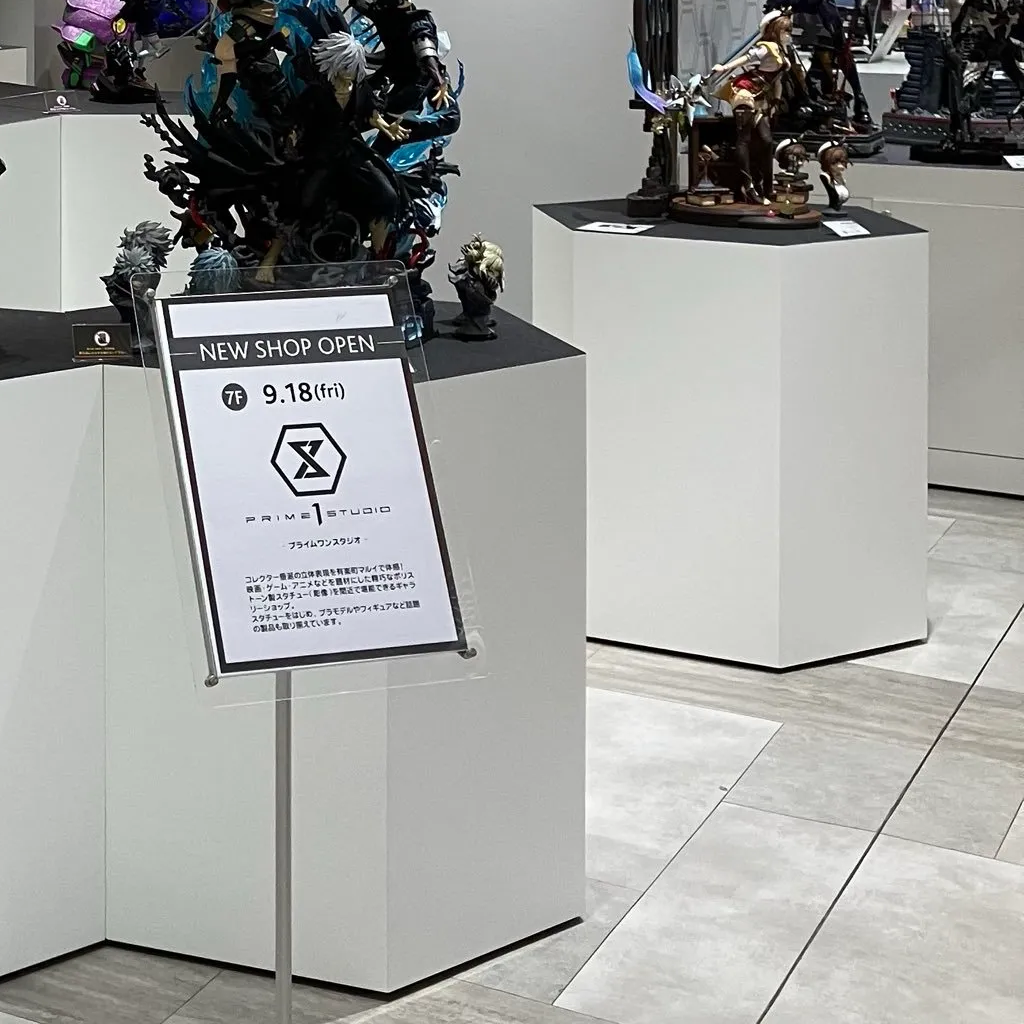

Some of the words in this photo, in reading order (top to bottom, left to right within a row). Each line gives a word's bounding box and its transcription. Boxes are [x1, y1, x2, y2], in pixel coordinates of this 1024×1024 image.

[199, 341, 249, 362] NEW
[254, 338, 312, 359] SHOP
[317, 334, 376, 355] OPEN
[224, 389, 244, 405] 7F
